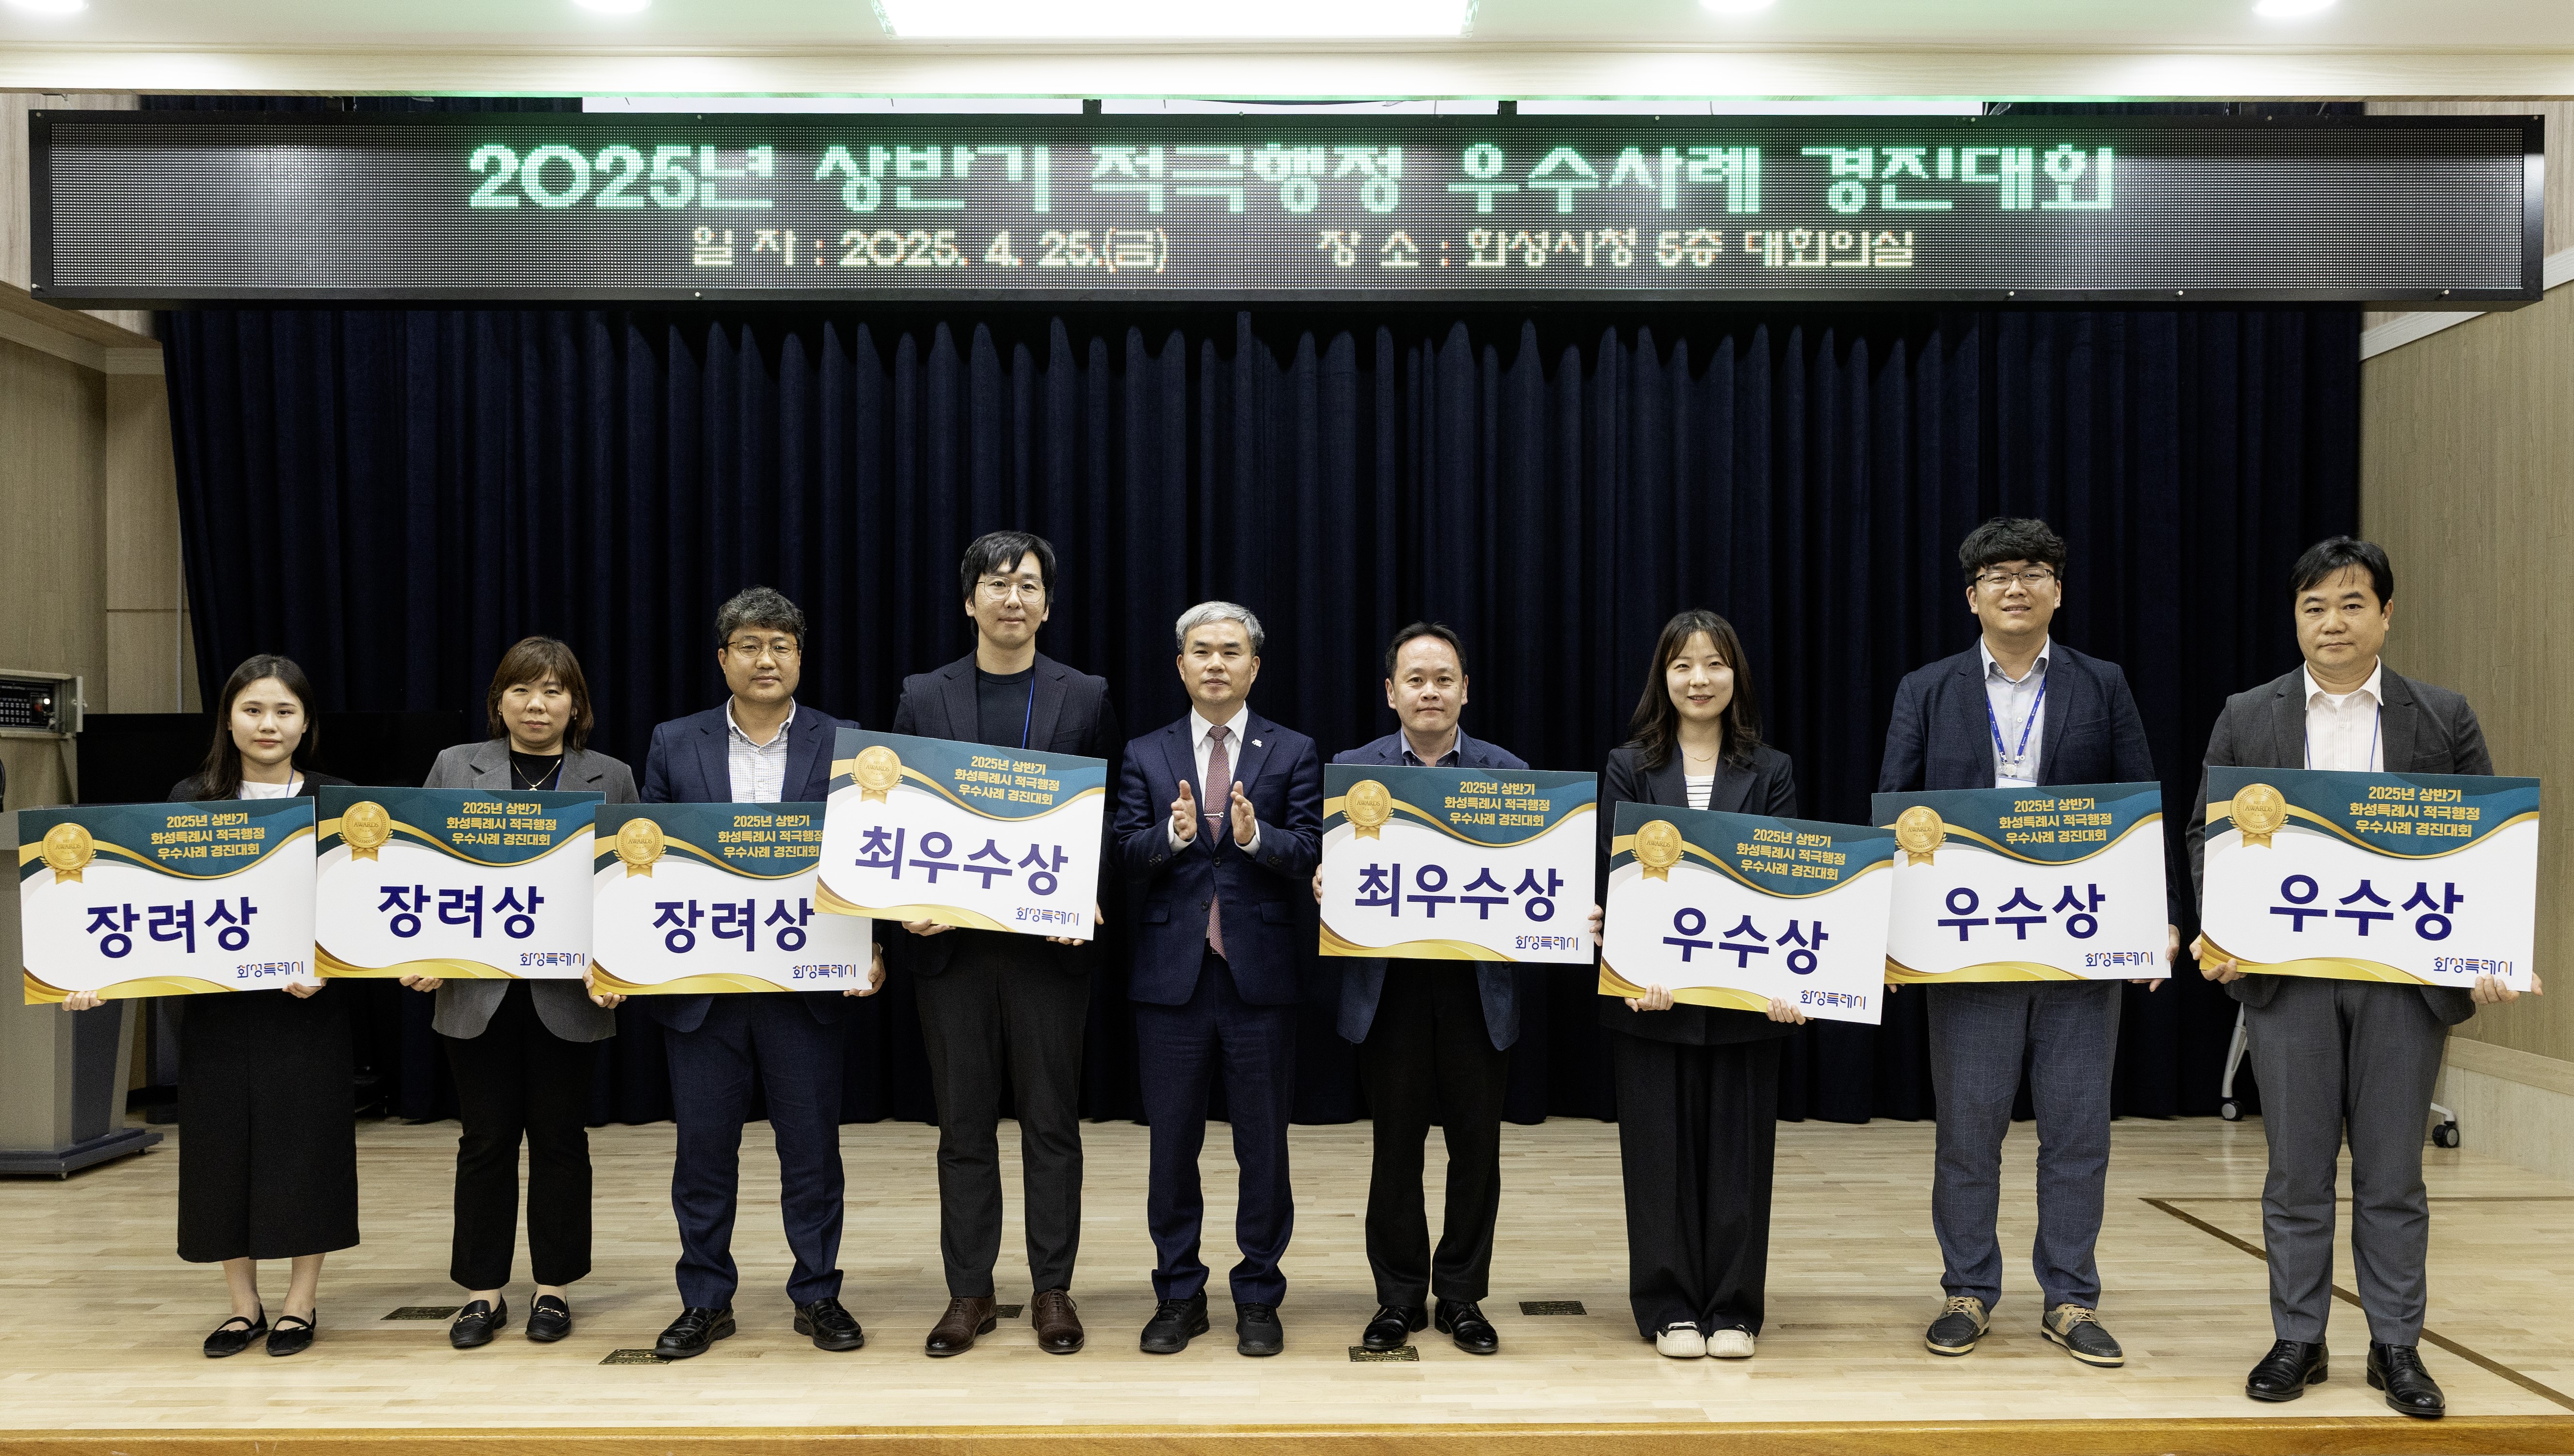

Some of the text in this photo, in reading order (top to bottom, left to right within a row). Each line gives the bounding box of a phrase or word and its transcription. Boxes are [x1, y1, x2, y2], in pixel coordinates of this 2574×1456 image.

[468, 142, 2115, 214] 2025년 상반기 적극행정 우수사례 경진대회
[693, 227, 733, 267] 일
[752, 228, 795, 267] 자
[839, 228, 969, 267] 2025.
[983, 230, 1023, 267] 4.
[1037, 227, 1167, 272] 25.(금)
[1316, 229, 1360, 267] 장
[1381, 230, 1419, 267] 소
[1468, 228, 1636, 267] 화성시청
[1656, 227, 1723, 267] 5층
[1745, 227, 1913, 267] 대회의실
[971, 756, 1046, 775] 2025년 상반기
[955, 768, 1059, 791] 화성특례시 적극행정
[1460, 782, 1535, 795] 2025년 상반기
[959, 784, 1052, 805] 우수사례 경진대회
[2368, 786, 2461, 802] 2025년 상반기
[463, 802, 541, 815] 2025년 상반기
[1444, 797, 1550, 811] 화성특례시 적극행정
[2014, 798, 2094, 812] 2025년 상반기
[2350, 802, 2479, 820] 화성특례시 적극행정
[167, 813, 248, 828] 2025년 상반기
[447, 817, 556, 830] 화성특례시 적극행정
[734, 815, 809, 827] 2025년 상반기
[1450, 813, 1544, 827] 우수사례 경진대회
[1999, 813, 2111, 829] 화성특례시 적극행정
[2356, 820, 2472, 837] 우수사례 경진대회
[151, 828, 265, 844] 화성특례시 적극행정
[452, 833, 550, 846] 우수사례 경진대회
[718, 830, 824, 843] 화성특례시 적극행정
[1753, 829, 1831, 848] 2025년 상반기
[2006, 829, 2106, 844] 우수사례 경진대회
[158, 843, 259, 860] 우수사례 경진대회
[724, 846, 819, 858] 우수사례 경진대회
[855, 826, 1068, 895] 최우수상
[1737, 843, 1845, 865] 화성특례시 적극행정
[1741, 859, 1838, 880] 우수사례 경진대회
[1355, 864, 1564, 922] 최우수상
[377, 885, 544, 939] 장려상
[1938, 884, 2105, 941] 우수상
[2270, 875, 2463, 941] 우수상
[86, 897, 257, 958] 장려상
[653, 898, 815, 953] 장려상
[1663, 908, 1828, 975] 우수상
